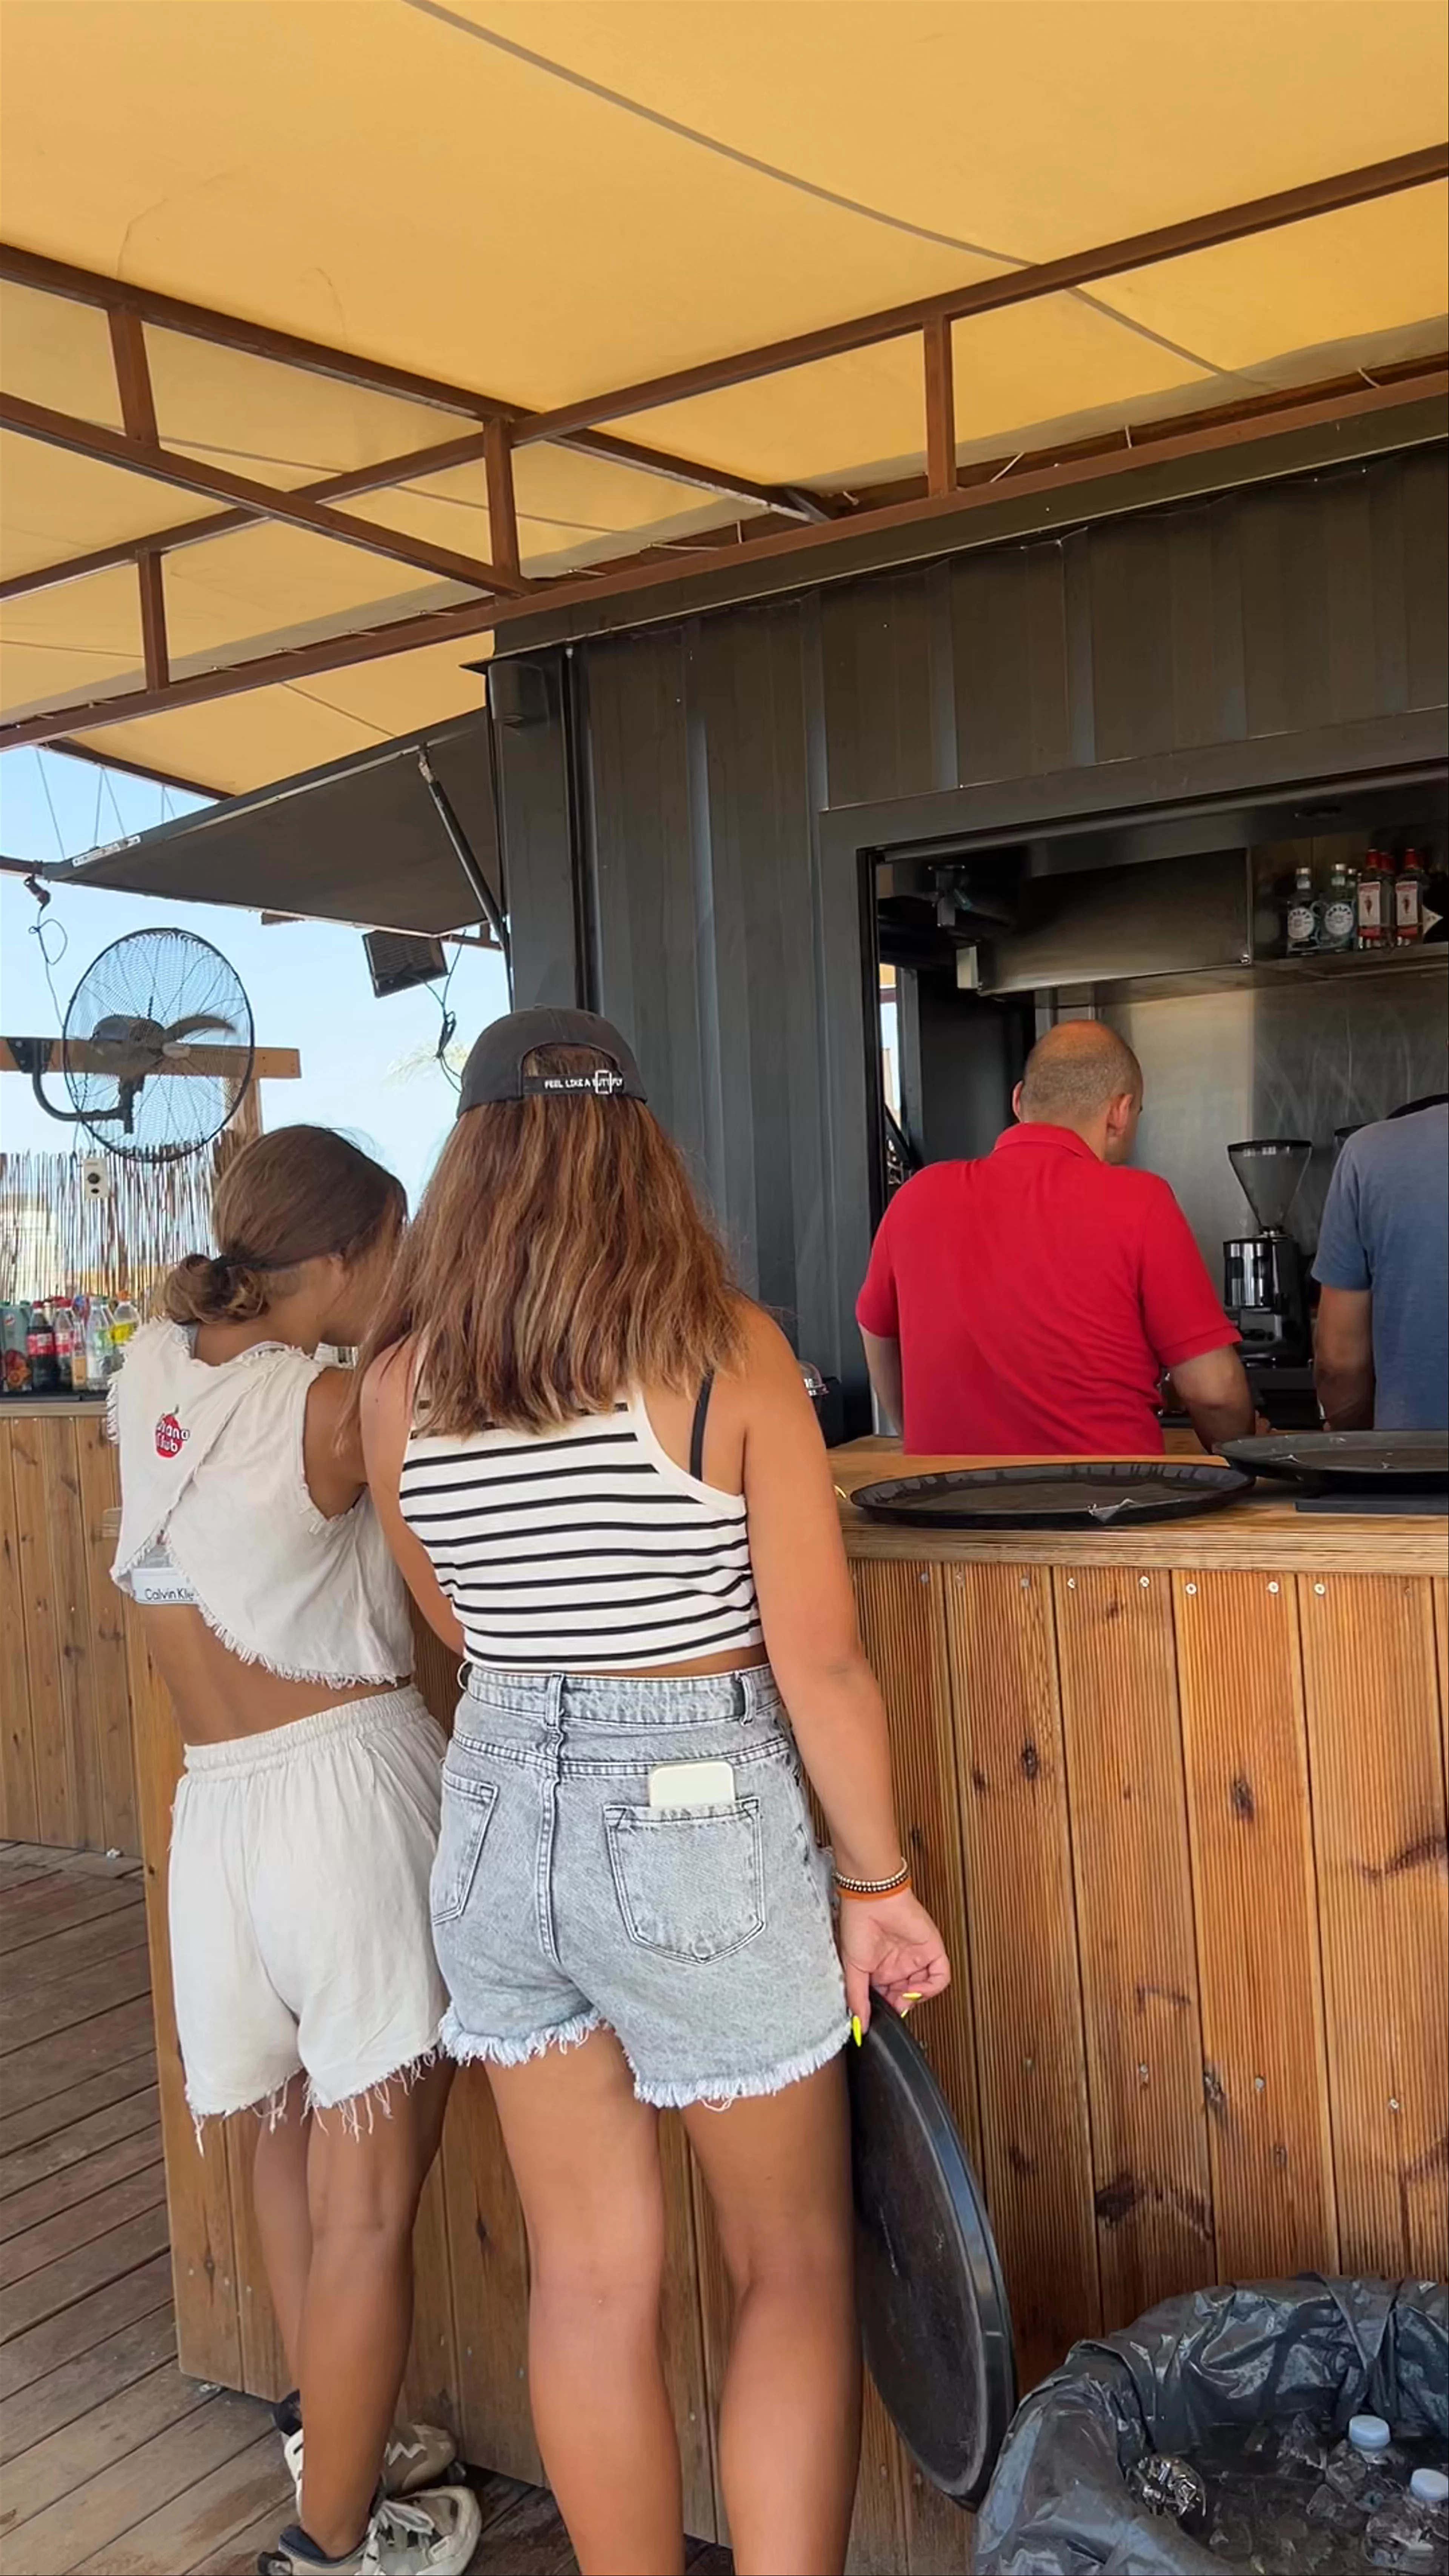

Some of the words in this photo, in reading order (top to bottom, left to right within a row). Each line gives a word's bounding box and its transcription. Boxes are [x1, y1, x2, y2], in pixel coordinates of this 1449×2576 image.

[545, 1079, 563, 1089] FEEL
[565, 1078, 583, 1088] LIKE
[584, 1078, 591, 1087] A
[144, 1588, 176, 1601] Calvin
